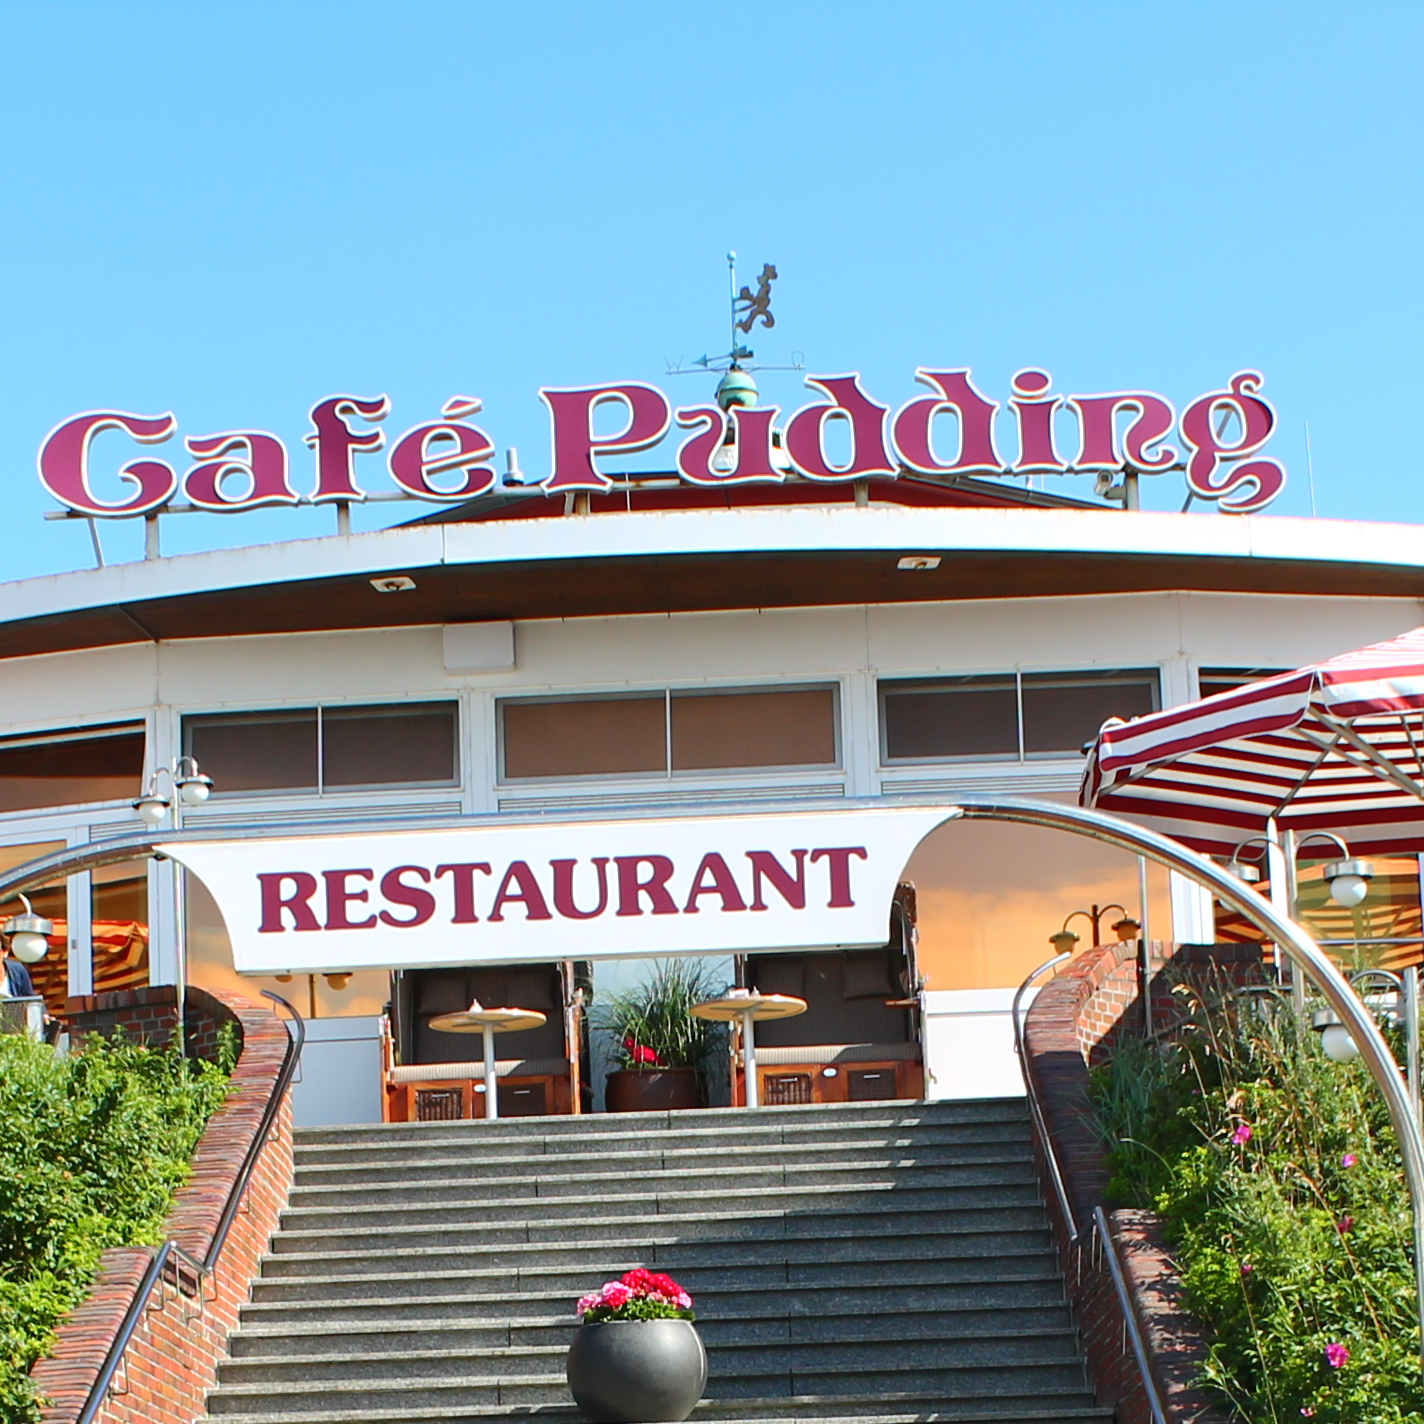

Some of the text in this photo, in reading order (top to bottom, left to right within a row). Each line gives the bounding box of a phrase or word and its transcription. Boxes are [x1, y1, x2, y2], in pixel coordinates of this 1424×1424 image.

[37, 367, 1287, 518] Café Pudding
[255, 845, 868, 934] RESTAURANT
